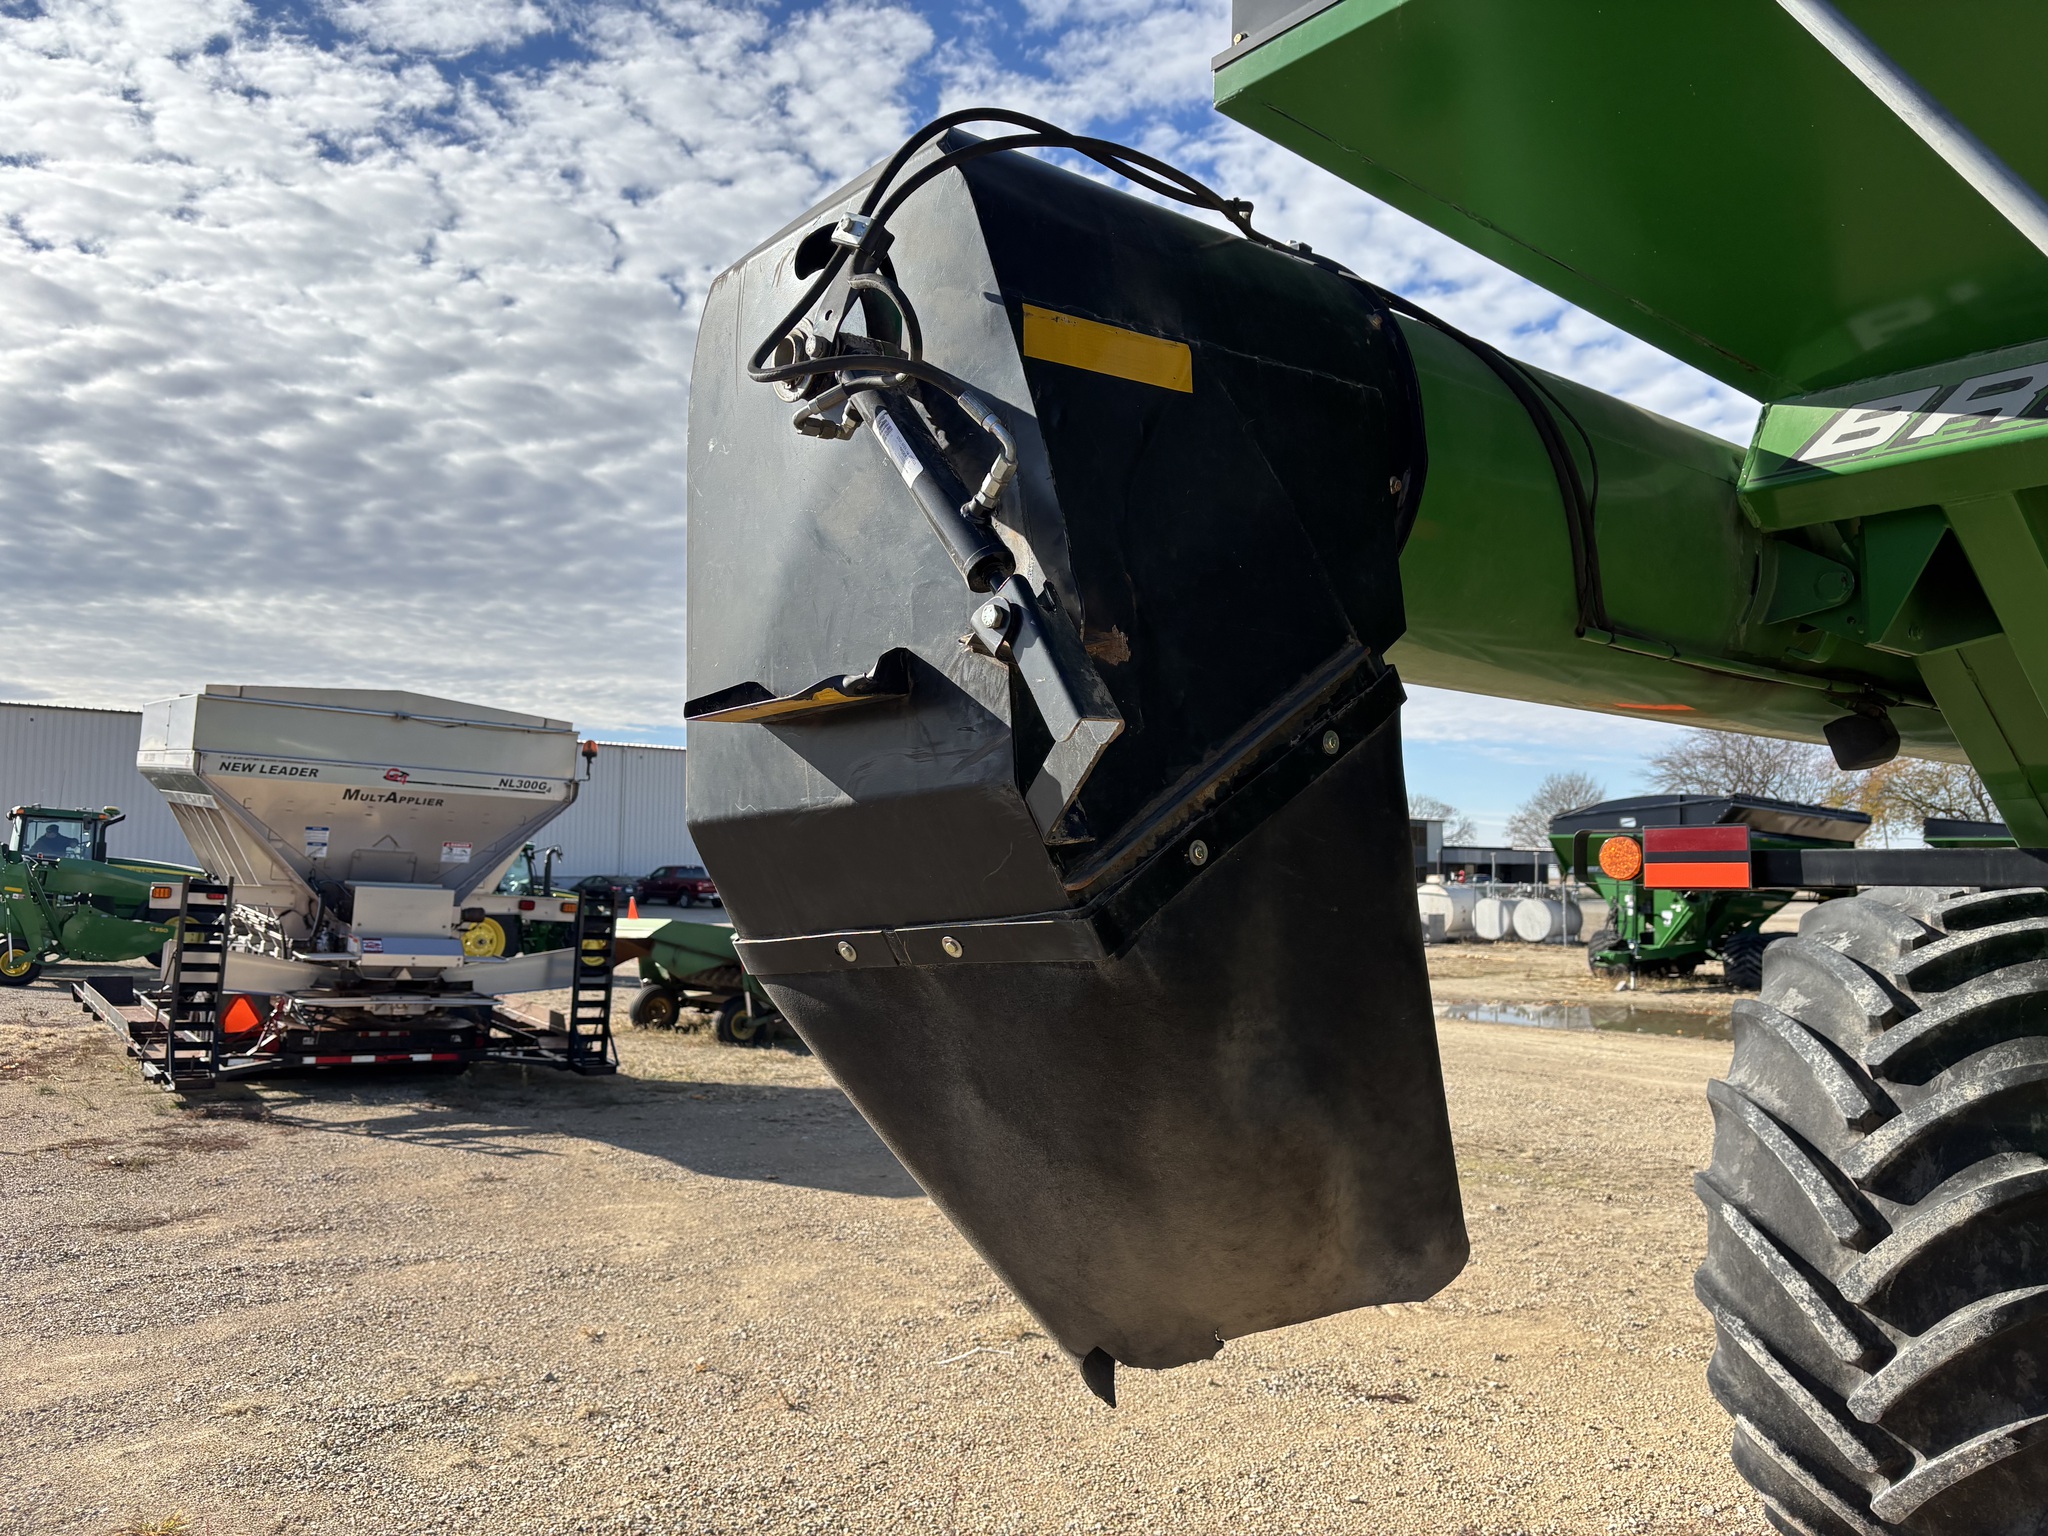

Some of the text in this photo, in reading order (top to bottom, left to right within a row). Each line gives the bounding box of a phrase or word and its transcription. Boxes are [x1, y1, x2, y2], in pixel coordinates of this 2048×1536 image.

[1797, 361, 2048, 462] BR
[219, 761, 319, 778] NEW LEADER
